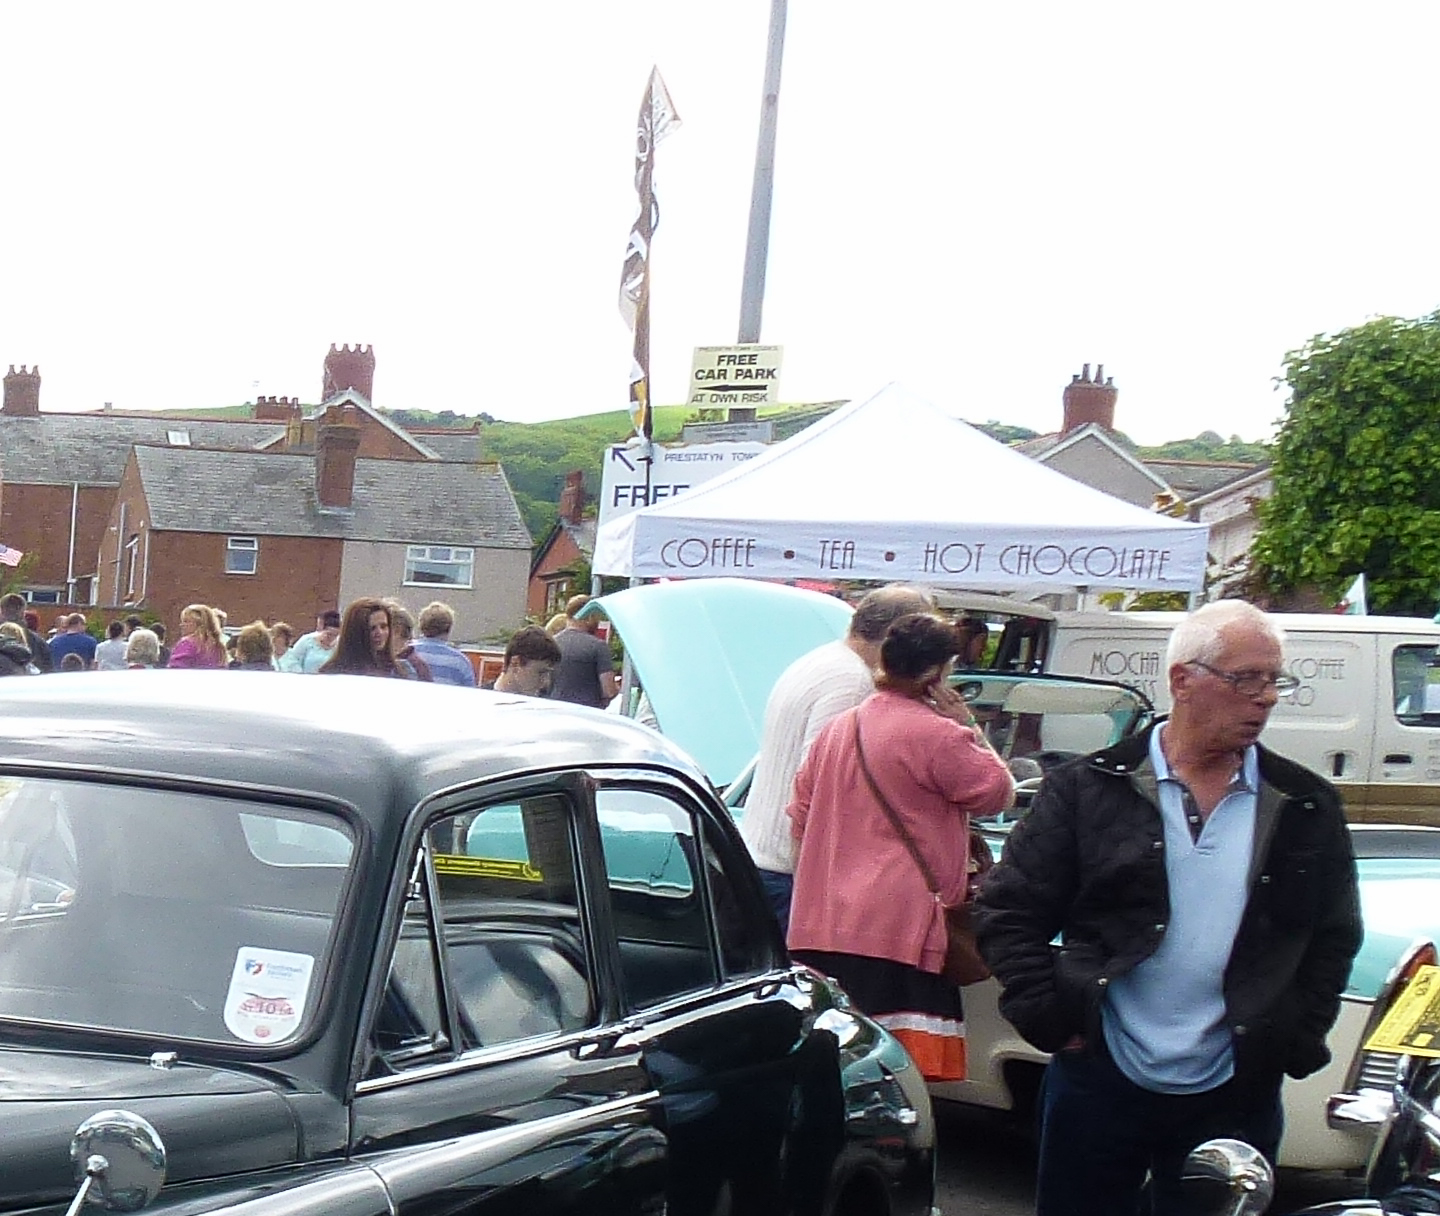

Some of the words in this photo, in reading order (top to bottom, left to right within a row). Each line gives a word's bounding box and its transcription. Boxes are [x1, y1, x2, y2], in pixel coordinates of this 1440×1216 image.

[717, 354, 758, 366] FREE
[694, 369, 728, 380] CAR
[734, 368, 777, 380] PARK
[691, 393, 706, 403] AT
[709, 394, 738, 403] OWN
[741, 393, 768, 403] RISK
[664, 452, 723, 462] PRESTATYN
[661, 538, 756, 568] COFFEE
[819, 540, 855, 569] TEA
[923, 543, 986, 573] HOT
[999, 545, 1171, 580] CHOCOLATE
[1090, 651, 1159, 676] MOCHA
[1290, 658, 1345, 680] COFFEE
